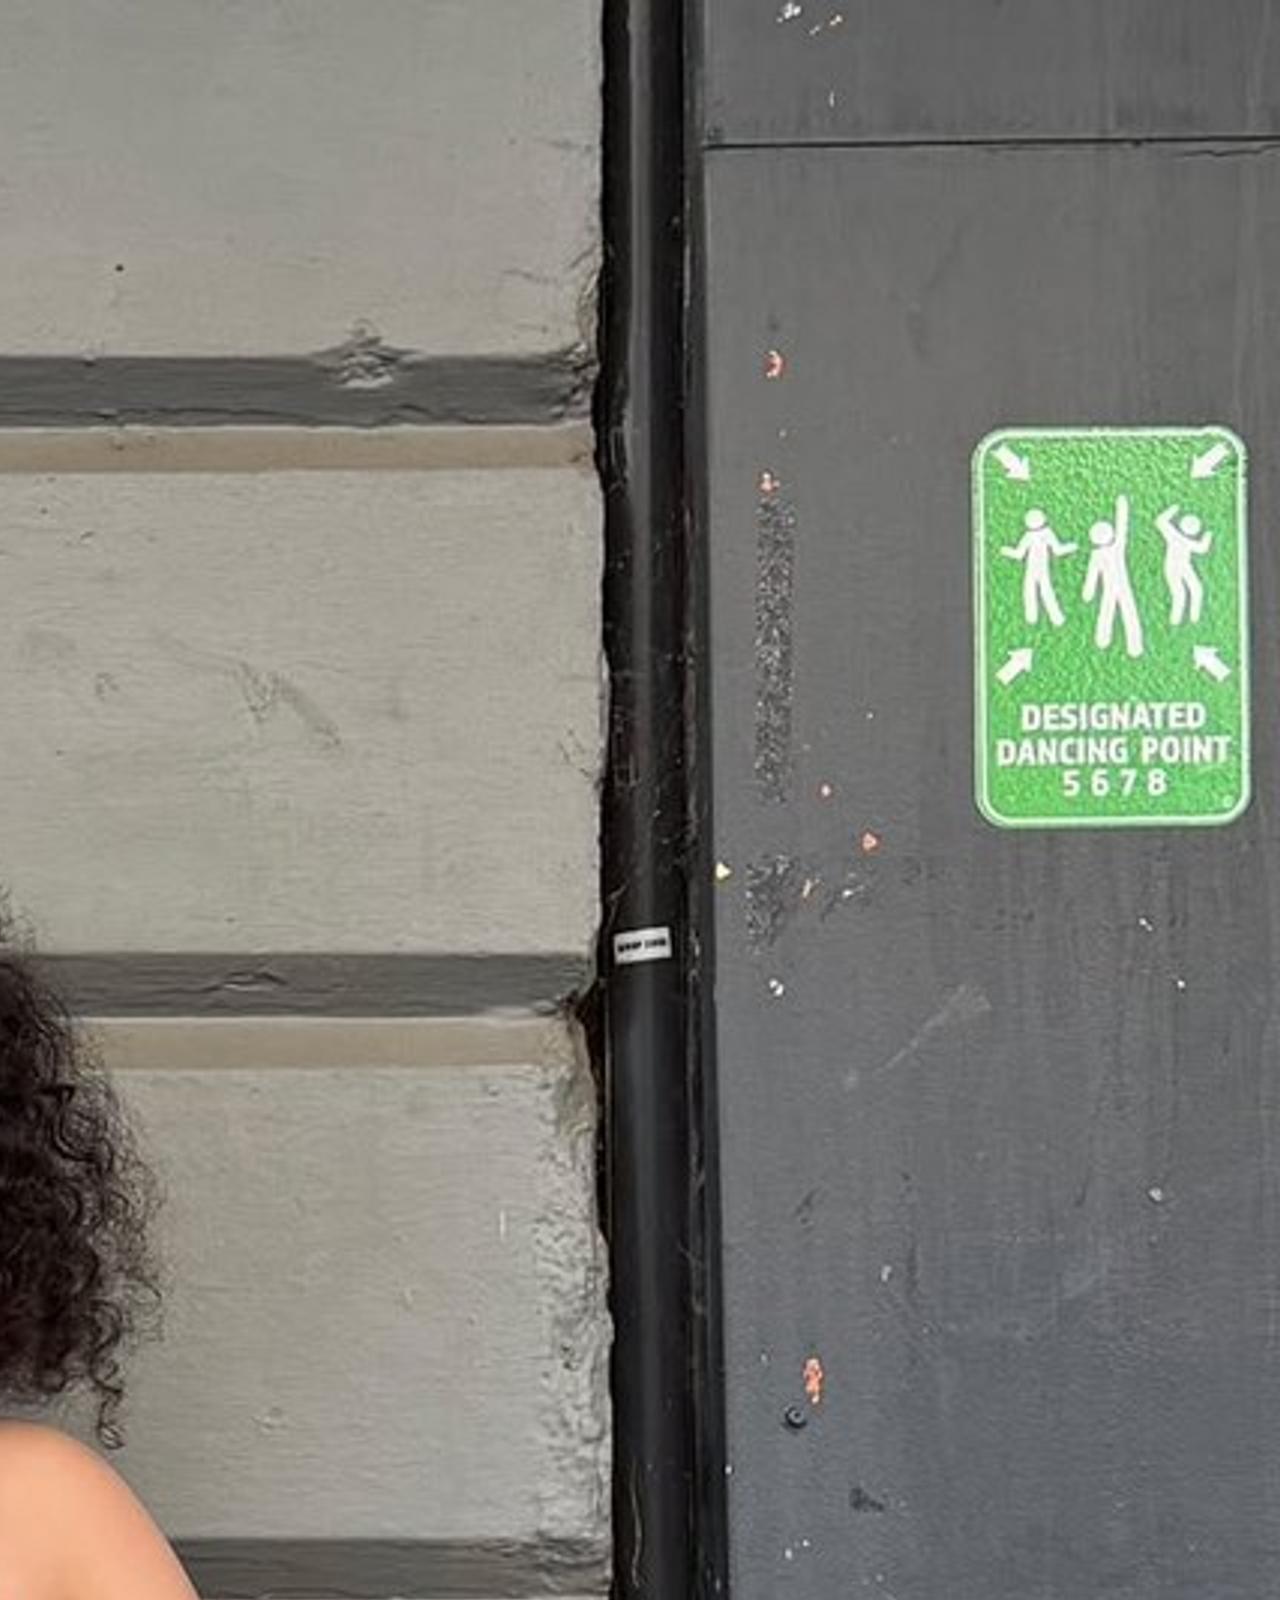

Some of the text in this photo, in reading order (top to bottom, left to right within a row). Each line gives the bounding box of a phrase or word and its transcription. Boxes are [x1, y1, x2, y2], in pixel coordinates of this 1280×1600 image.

[1022, 703, 1207, 731] DESIGNATED
[996, 735, 1232, 766] DANCING POINT
